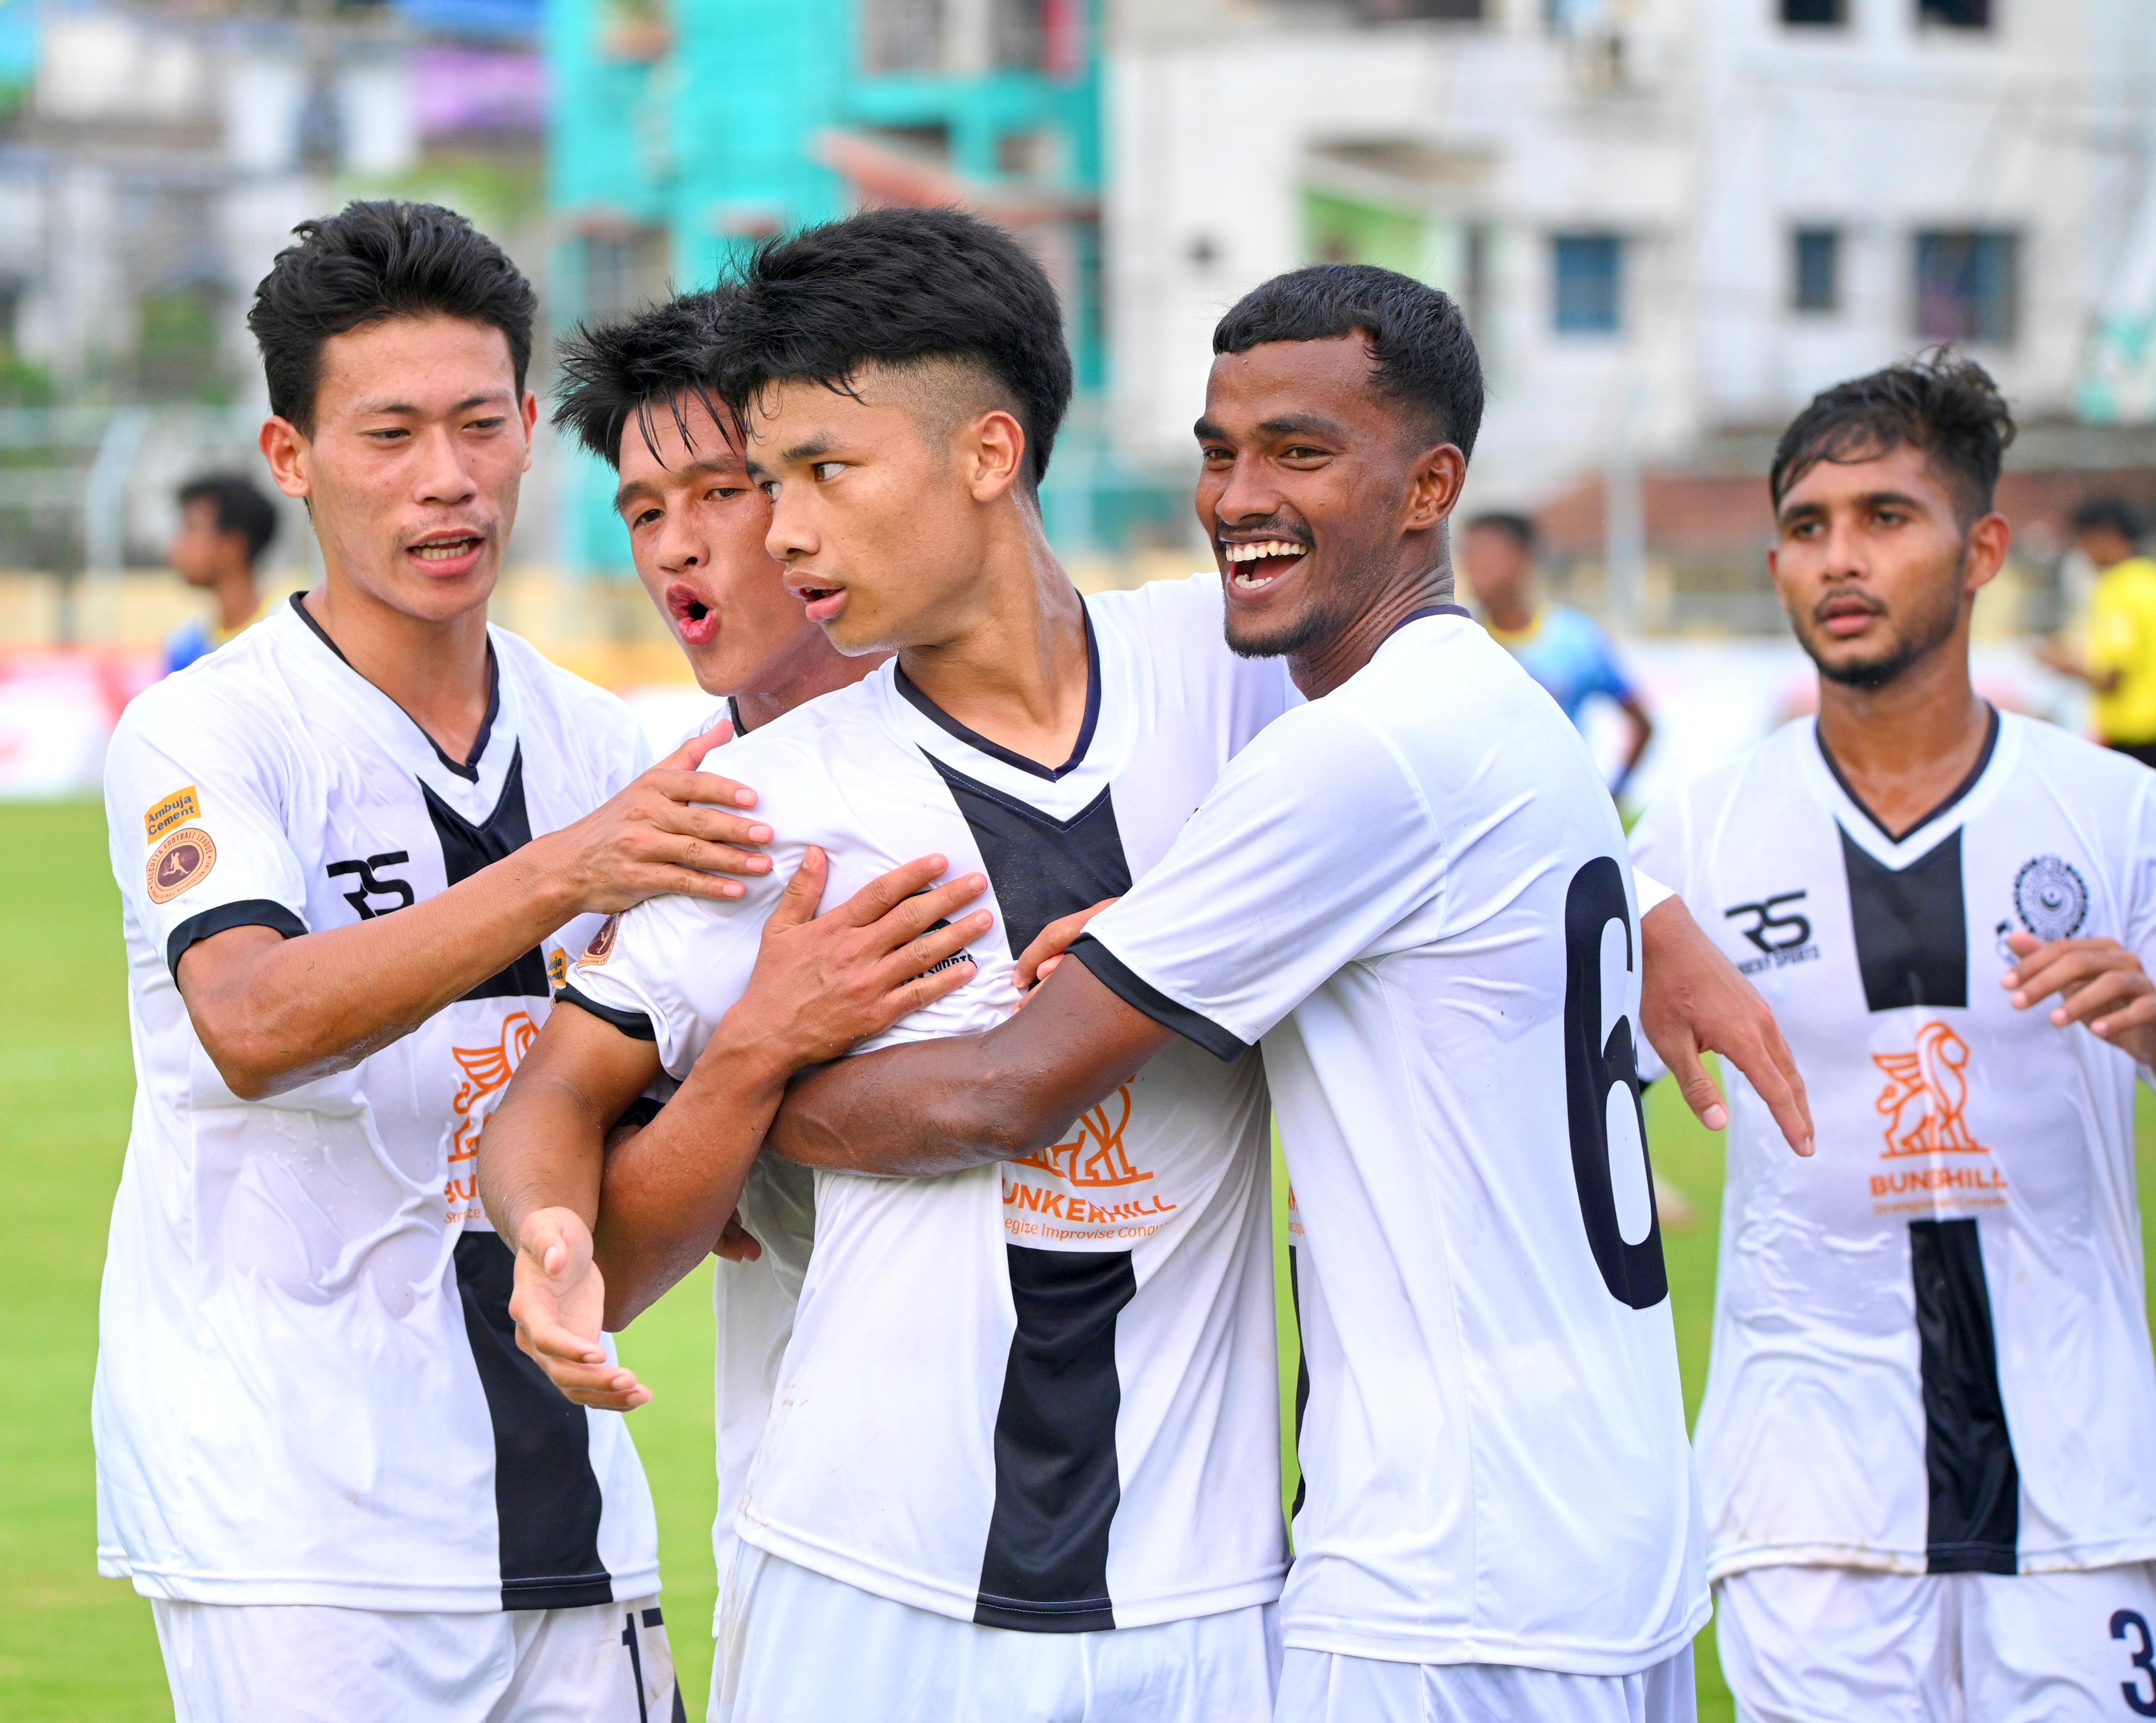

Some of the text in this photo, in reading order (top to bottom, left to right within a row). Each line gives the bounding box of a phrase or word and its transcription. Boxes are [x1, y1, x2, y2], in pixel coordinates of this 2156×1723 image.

[148, 796, 192, 824] Ambuja
[148, 805, 195, 836] Cement
[148, 831, 213, 886] CALCUTTA FOOTBALL LEAGUE
[1725, 891, 1810, 953] RS
[1564, 856, 1668, 1309] 6
[1002, 1178, 1178, 1224] UNKERHILL
[1004, 1218, 1039, 1235] egize
[1042, 1223, 1115, 1241] Improvise
